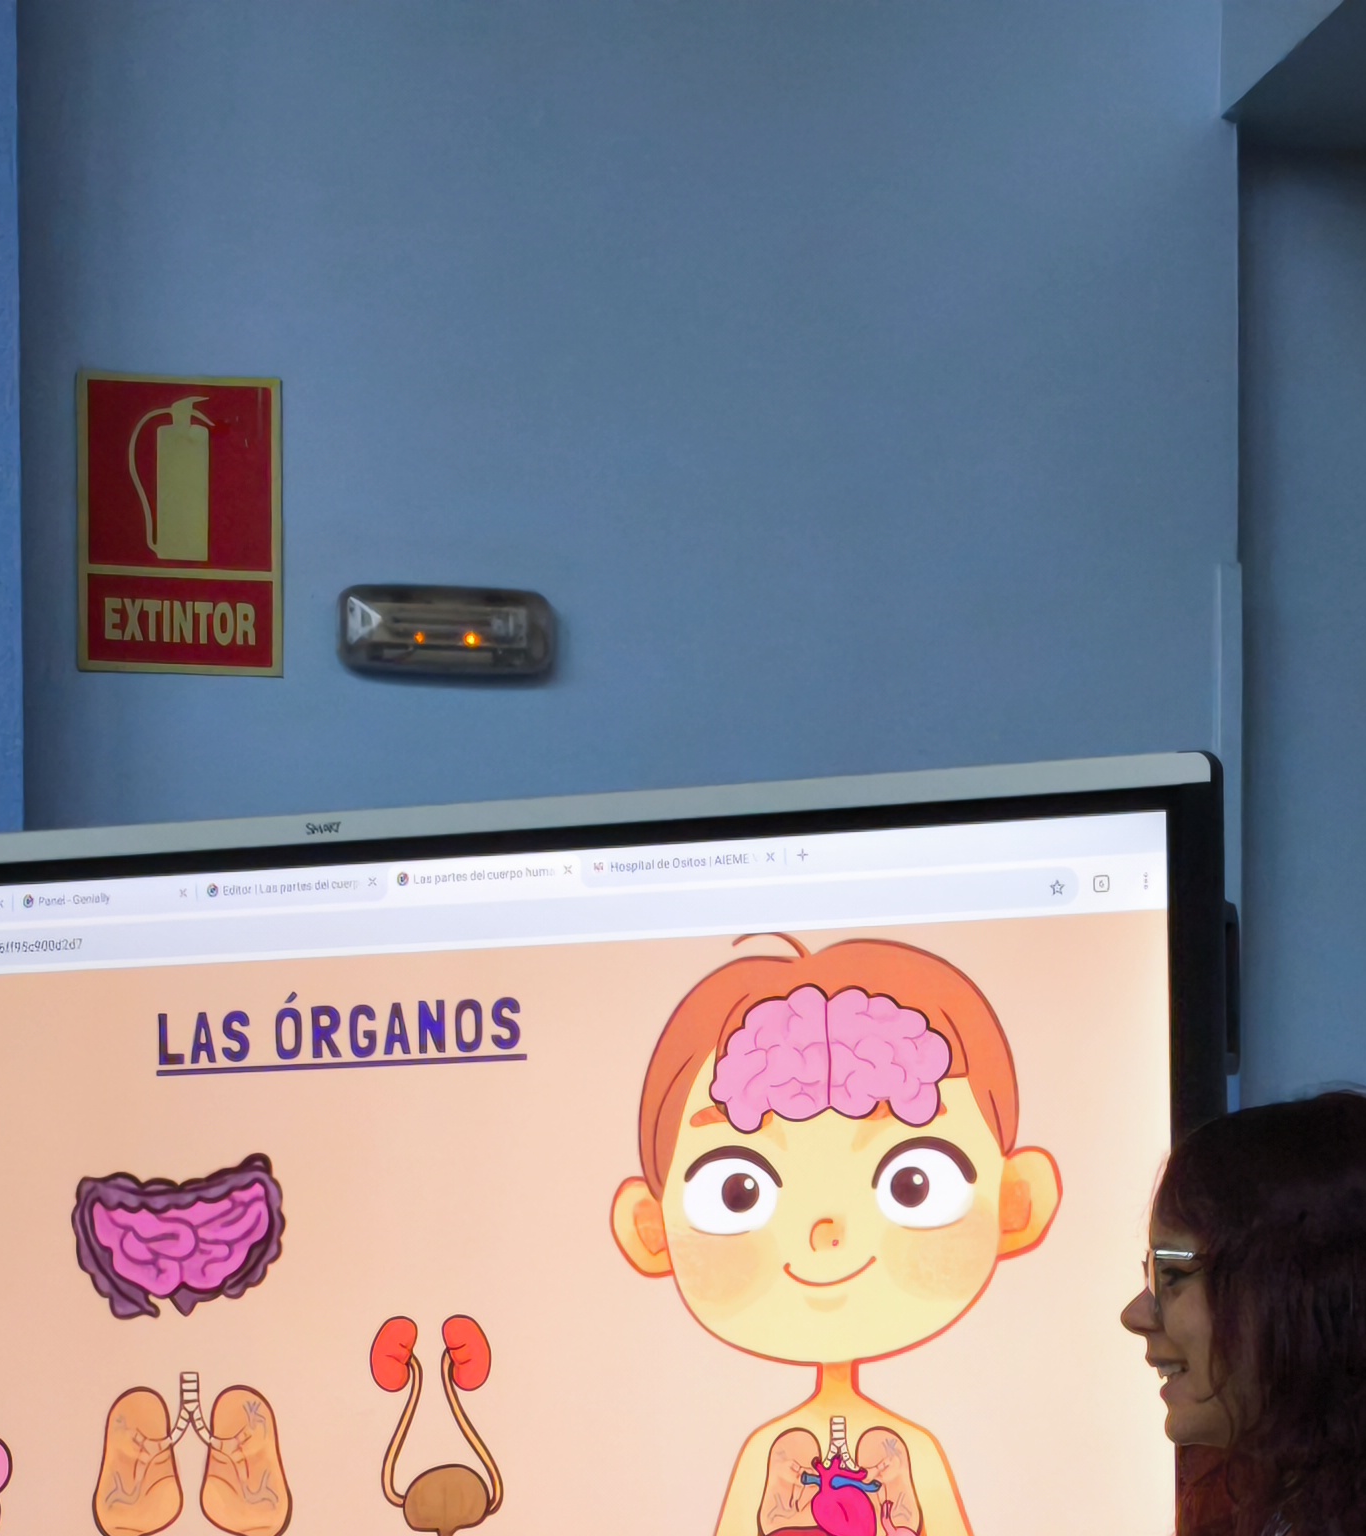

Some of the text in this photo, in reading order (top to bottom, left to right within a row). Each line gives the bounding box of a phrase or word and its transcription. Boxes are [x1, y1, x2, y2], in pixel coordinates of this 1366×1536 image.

[103, 596, 257, 647] EXTINTOR
[305, 821, 342, 836] SMART
[610, 859, 655, 874] Hospital
[657, 858, 670, 869] de
[672, 856, 707, 869] Ositos
[714, 853, 750, 866] AIEME
[434, 872, 468, 885] partes
[470, 870, 485, 881] del
[487, 868, 523, 881] cuerpo
[223, 884, 252, 896] Editor
[280, 881, 312, 895] partes
[314, 879, 330, 890] del
[38, 894, 66, 906] Panel
[72, 892, 110, 905] Genially
[157, 991, 521, 1066] LAS ÓRGANOS
